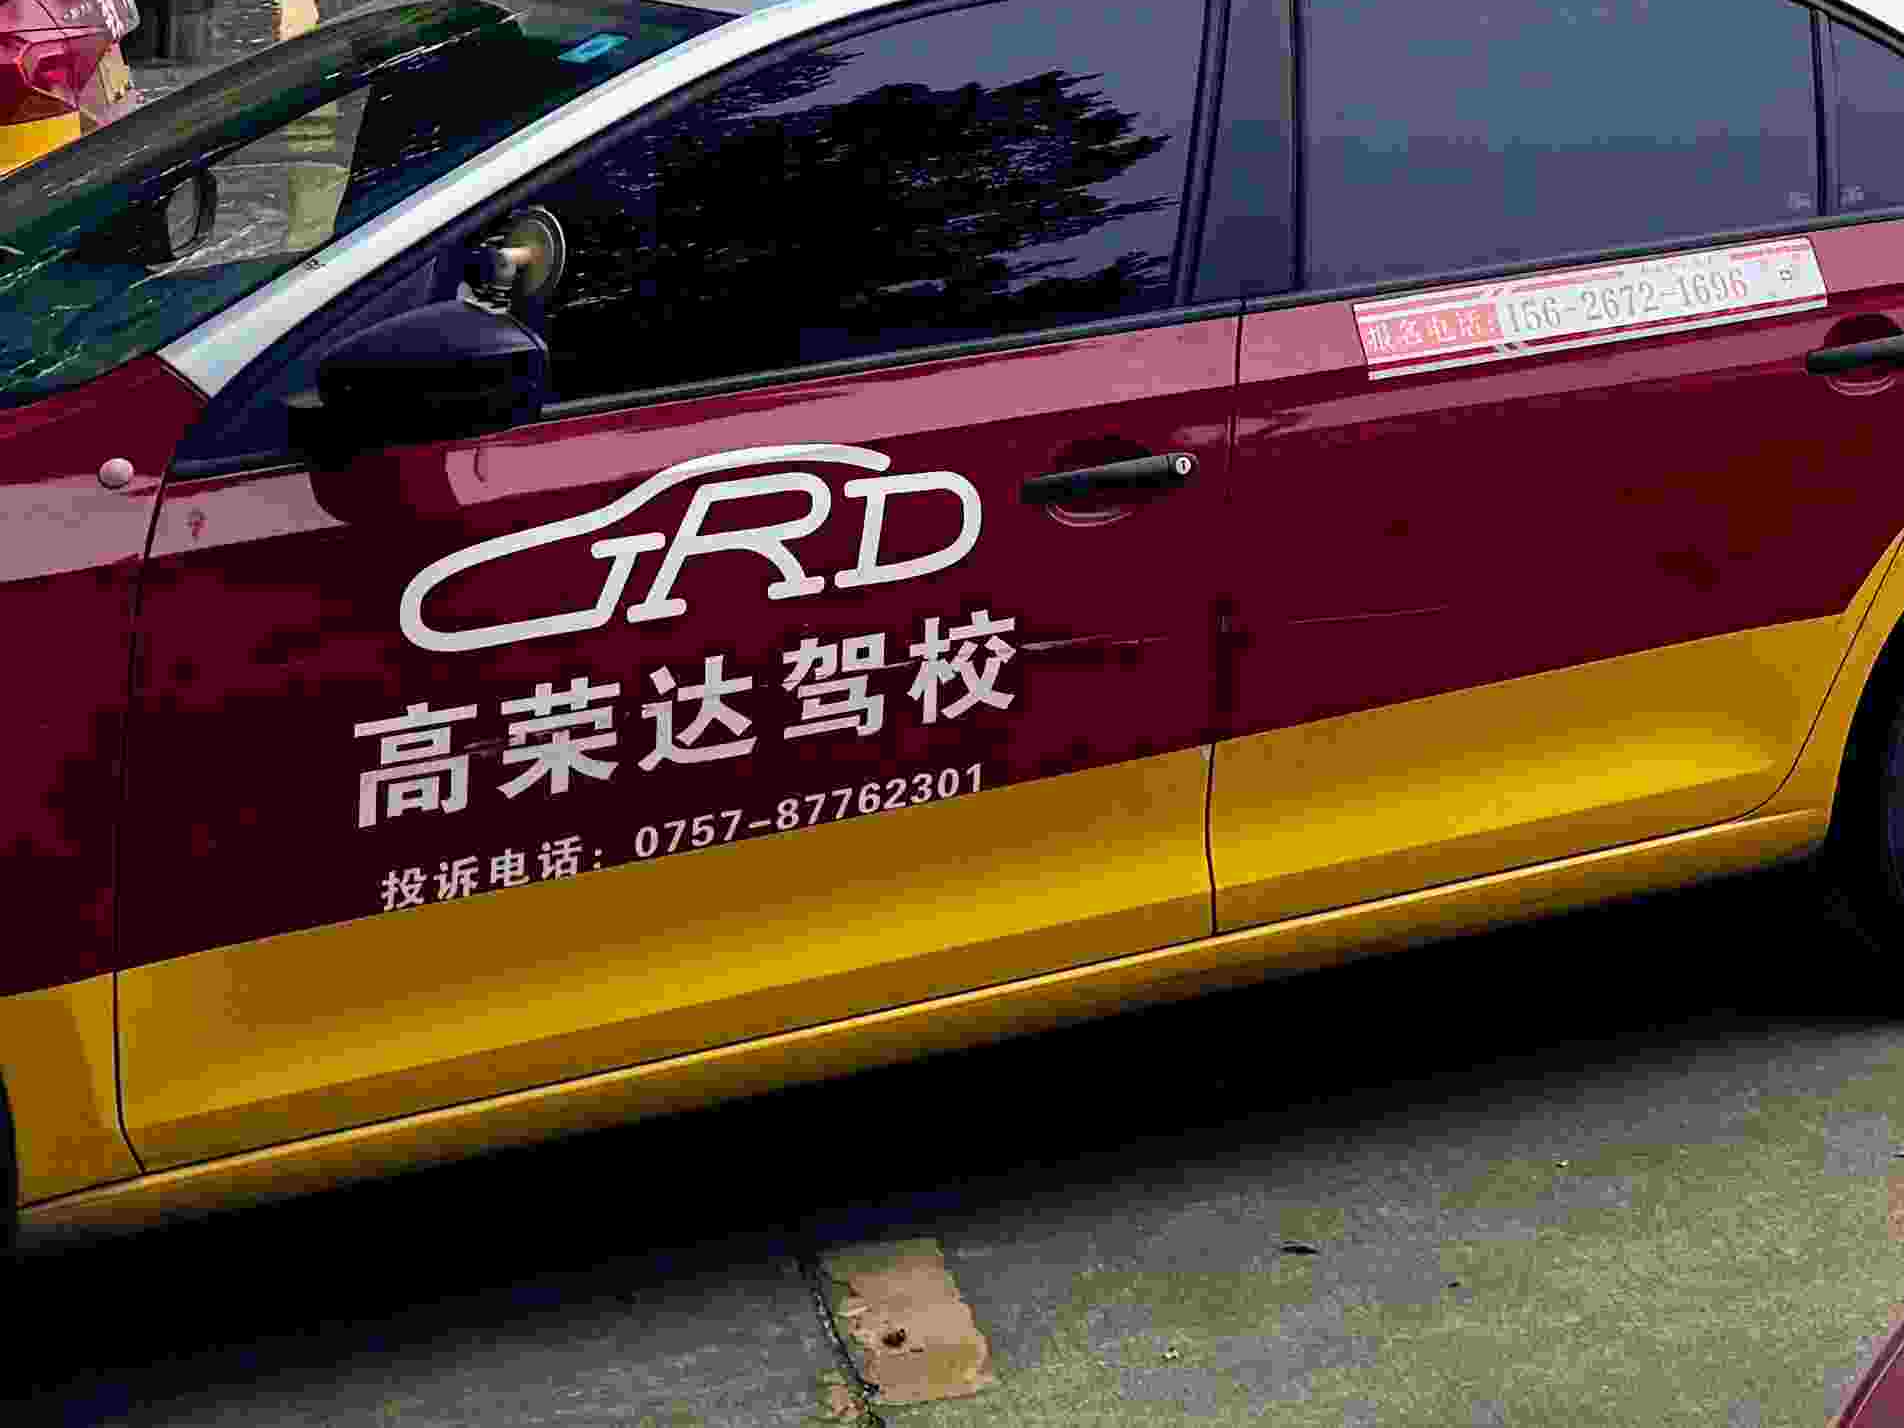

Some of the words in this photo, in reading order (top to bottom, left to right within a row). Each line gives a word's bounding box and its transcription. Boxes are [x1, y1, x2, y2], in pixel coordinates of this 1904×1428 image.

[400, 443, 982, 653] GRD
[352, 609, 1017, 830] 高荣达驾校
